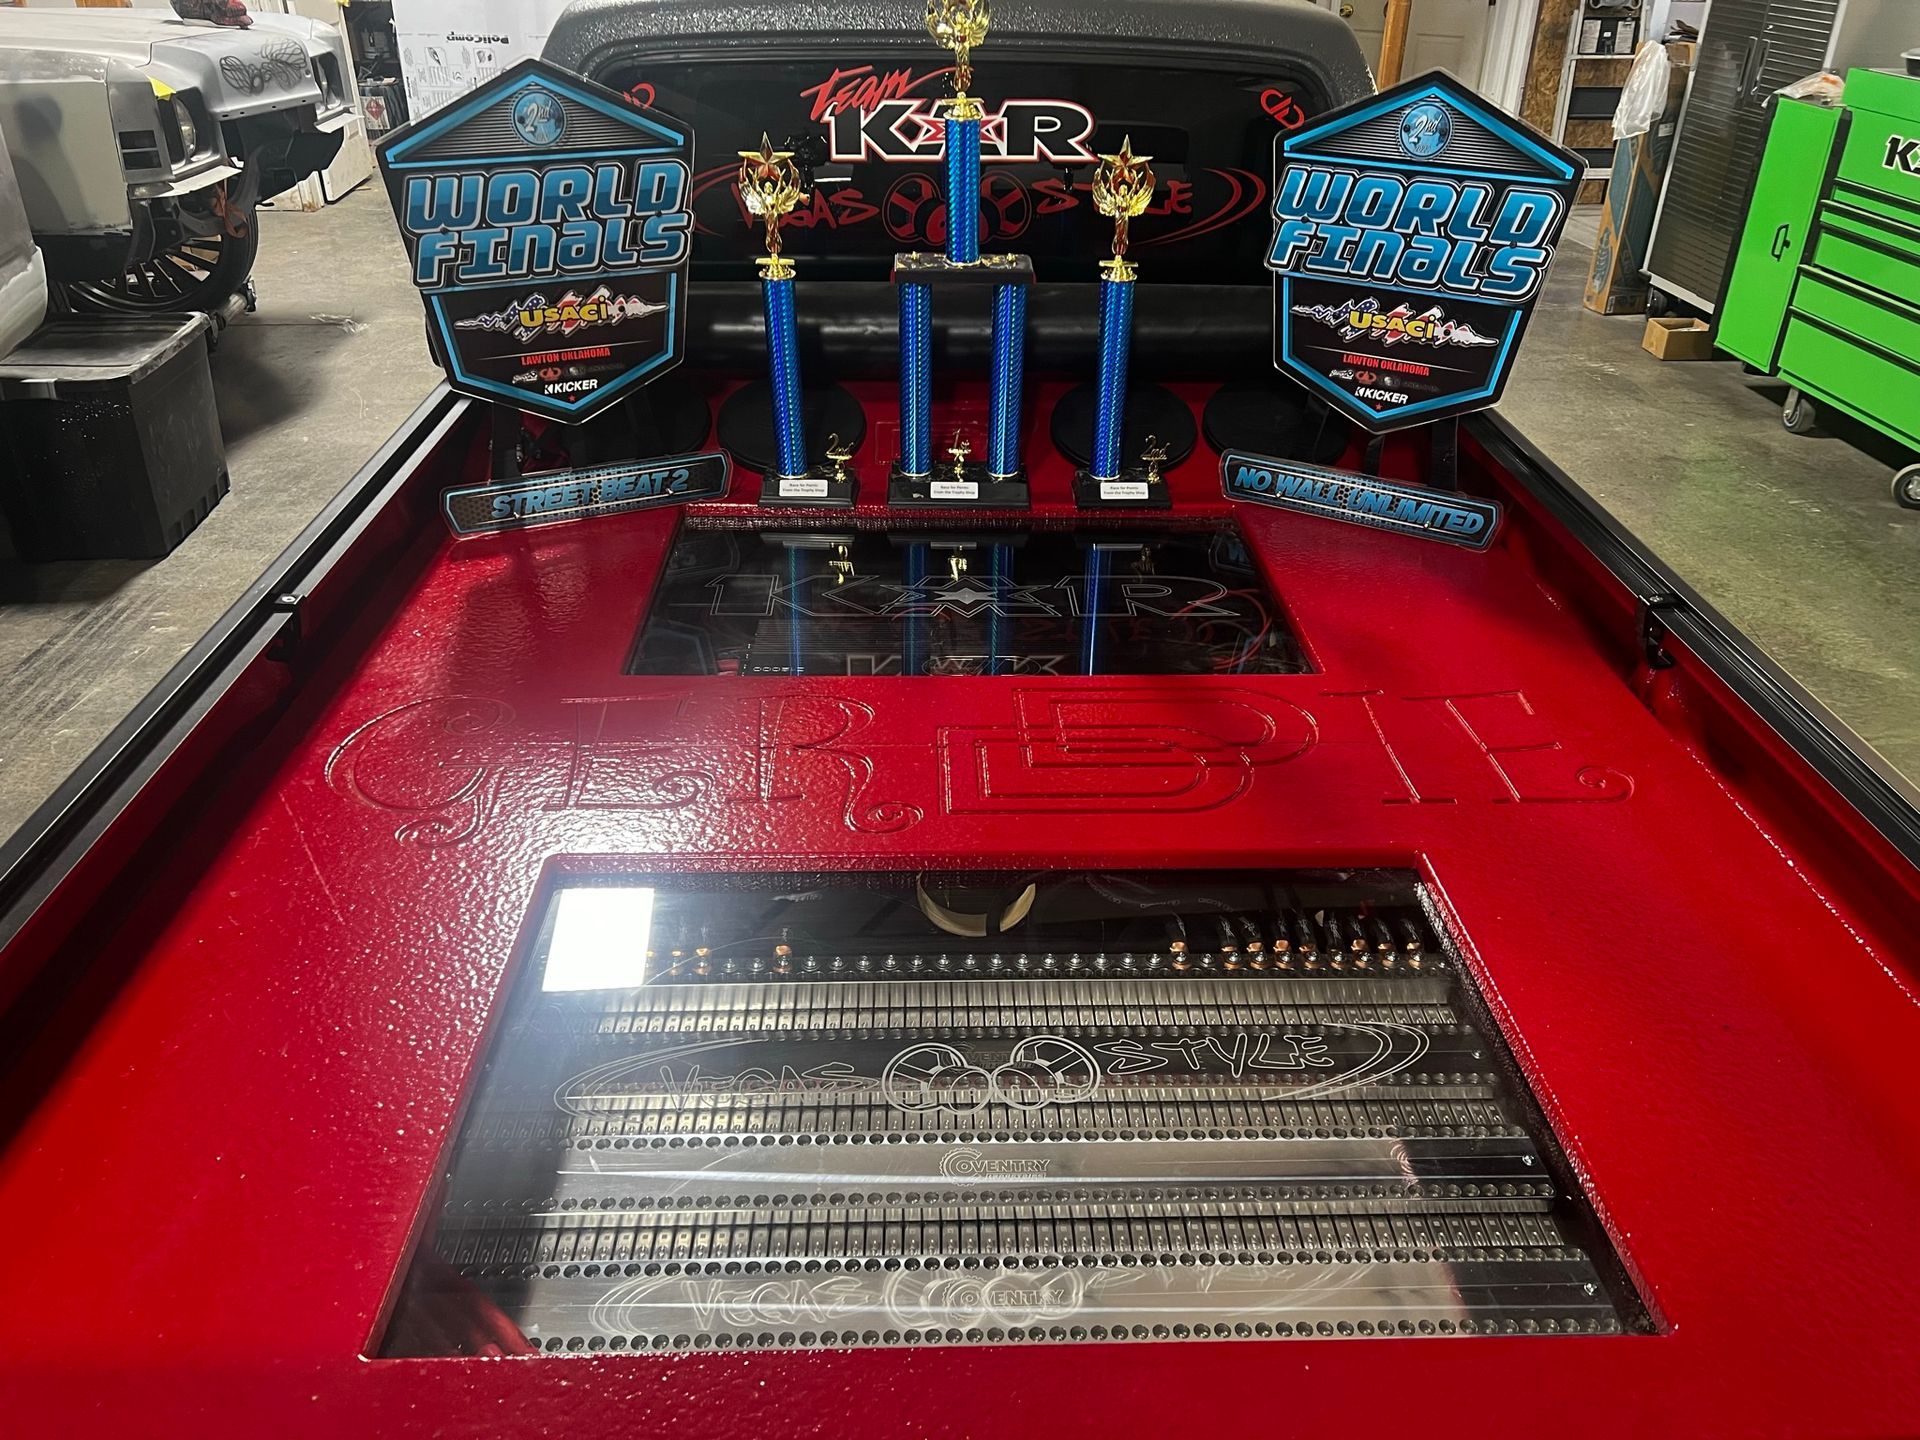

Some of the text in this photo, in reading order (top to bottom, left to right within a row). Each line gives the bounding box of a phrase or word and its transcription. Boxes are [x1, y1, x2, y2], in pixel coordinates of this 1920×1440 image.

[1408, 113, 1443, 143] 2nd
[406, 160, 688, 232] WORLD
[1276, 168, 1558, 246] WORLD
[521, 347, 611, 366] LAWTON OKLAHOMA
[1343, 354, 1430, 376] LAWTON OKLAHOMA
[554, 379, 599, 394] KICKER
[1364, 387, 1409, 405] KICKER
[491, 468, 690, 519] STREET BEAT 2
[1234, 466, 1485, 536] NO WALL UNLIMITED
[1093, 1033, 1335, 1078] STYLE
[939, 1146, 1051, 1187] COVENTRY
